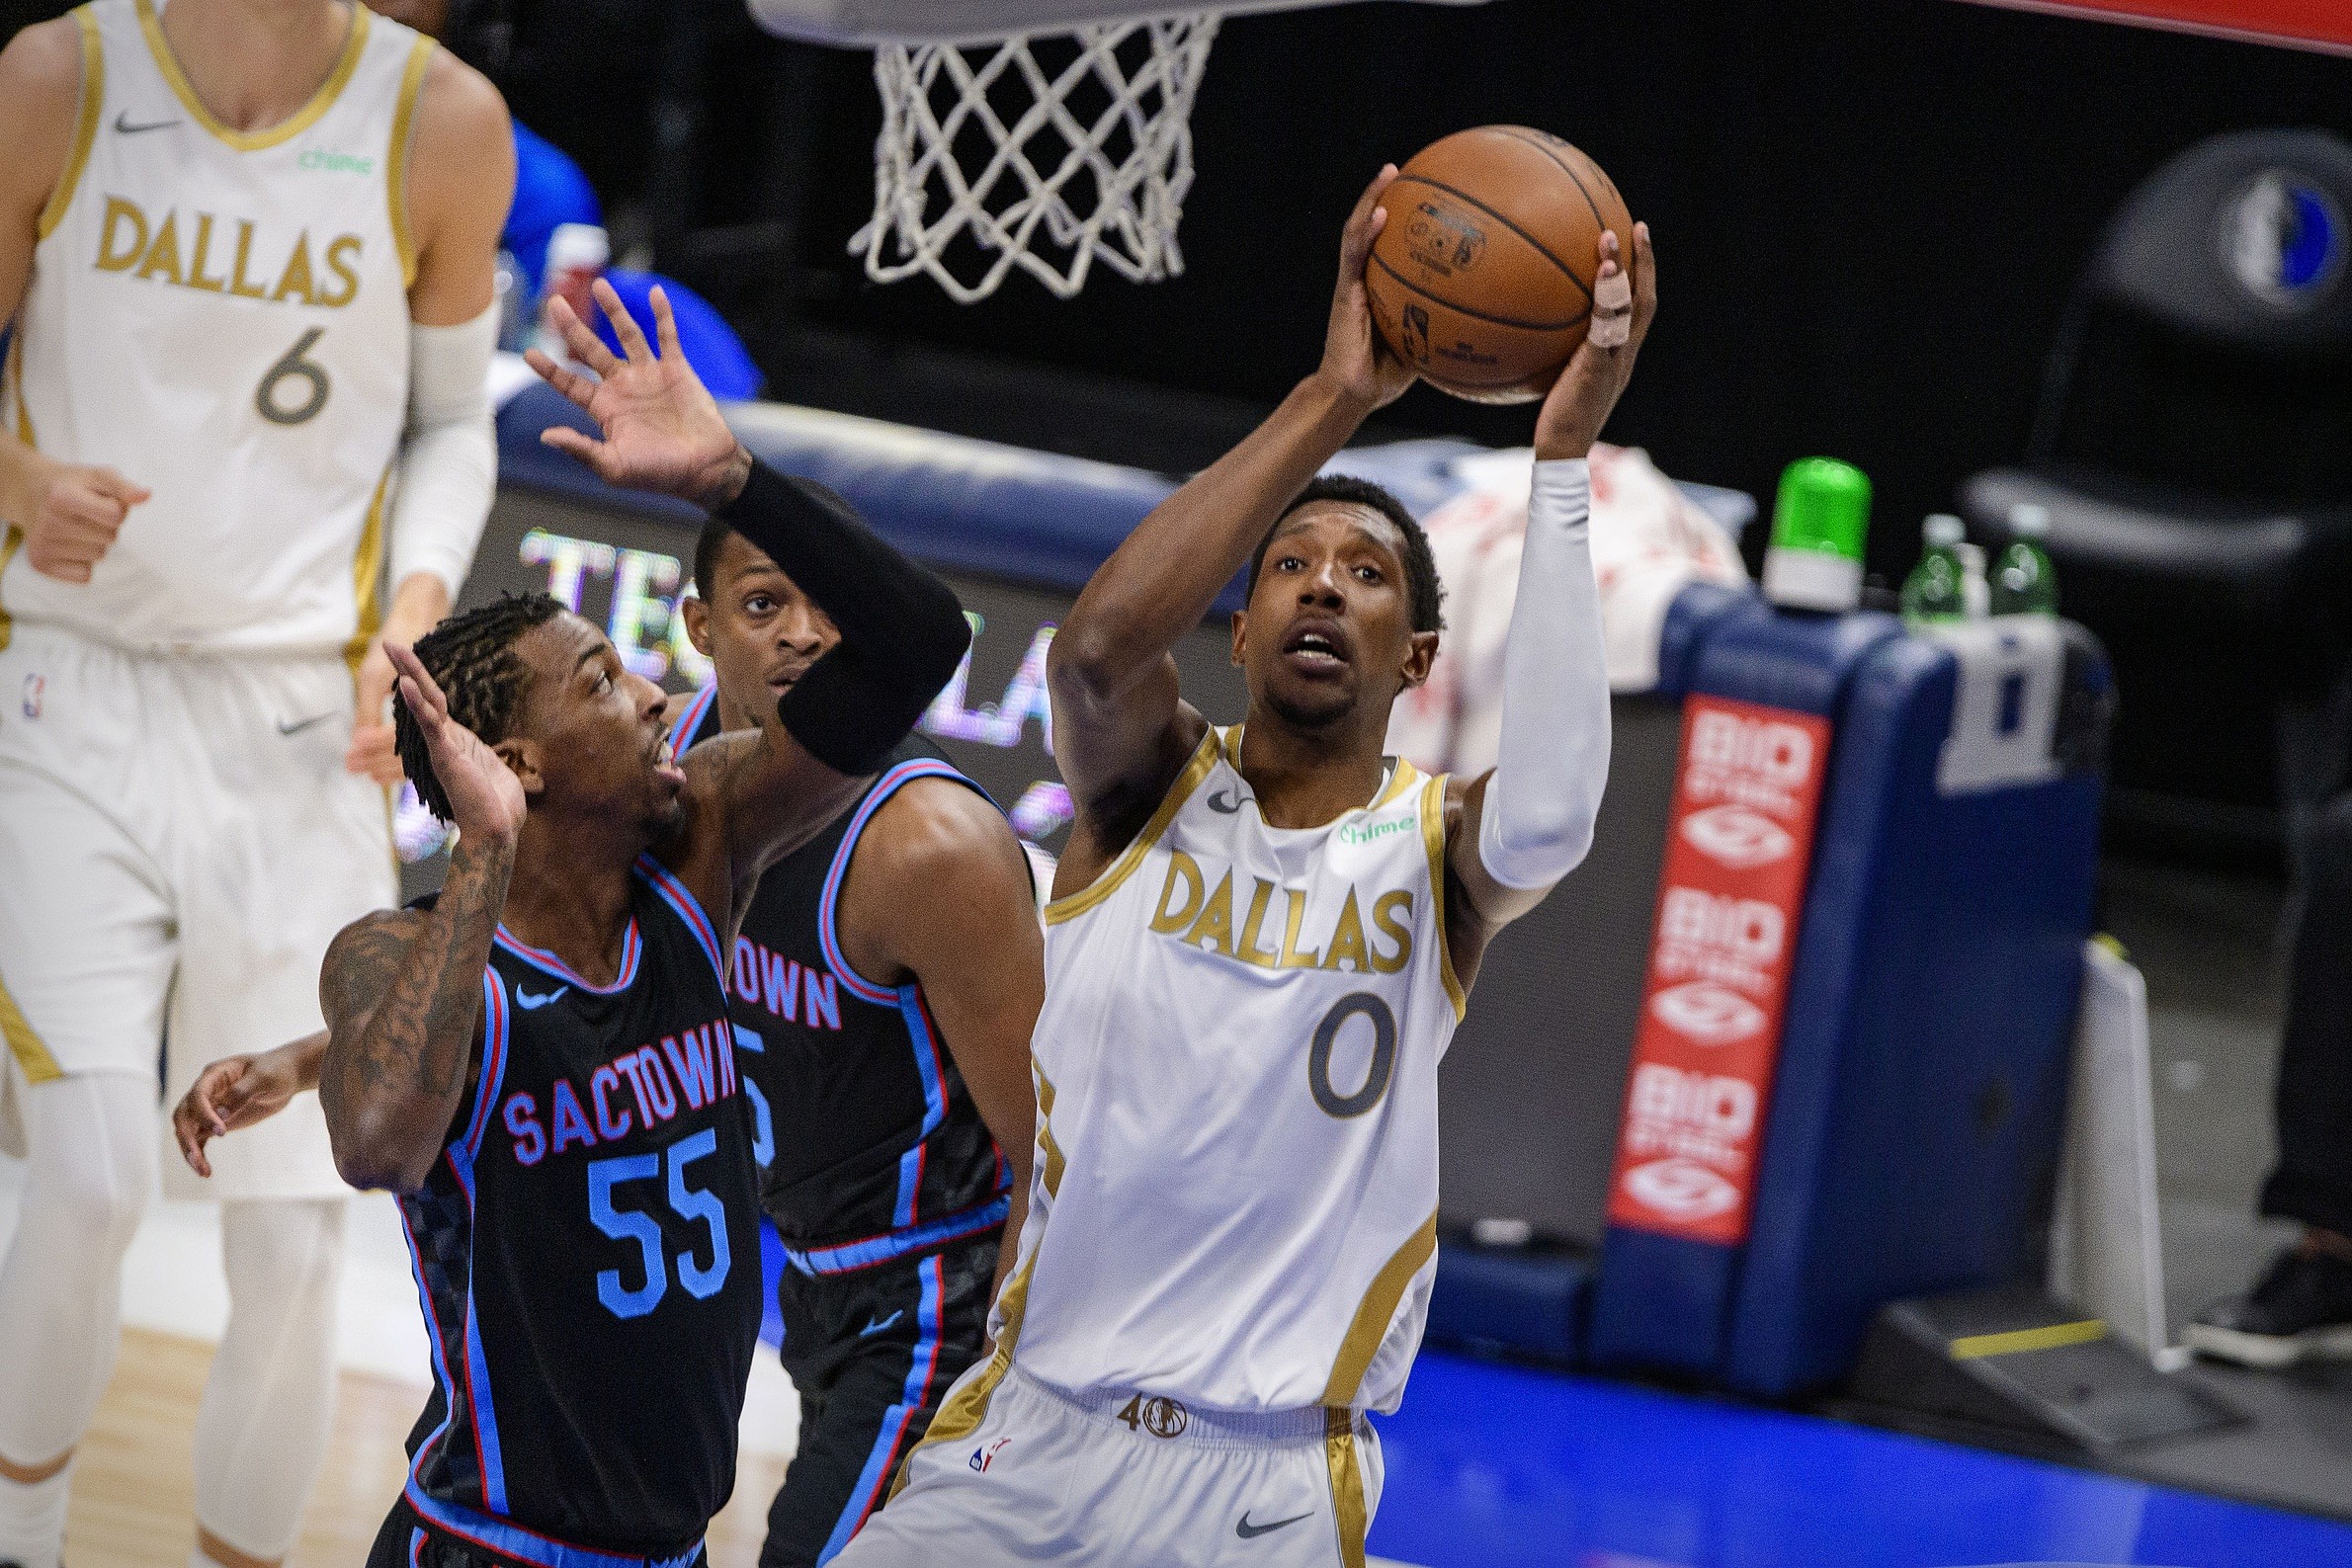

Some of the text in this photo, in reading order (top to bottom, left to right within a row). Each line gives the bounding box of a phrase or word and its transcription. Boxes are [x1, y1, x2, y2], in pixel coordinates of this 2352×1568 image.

[94, 195, 364, 309] DALLAS
[254, 327, 333, 427] 6
[1338, 815, 1415, 845] chime
[1148, 847, 1415, 975] DALLAS
[1307, 991, 1398, 1120] 0
[587, 1125, 732, 1320] 55
